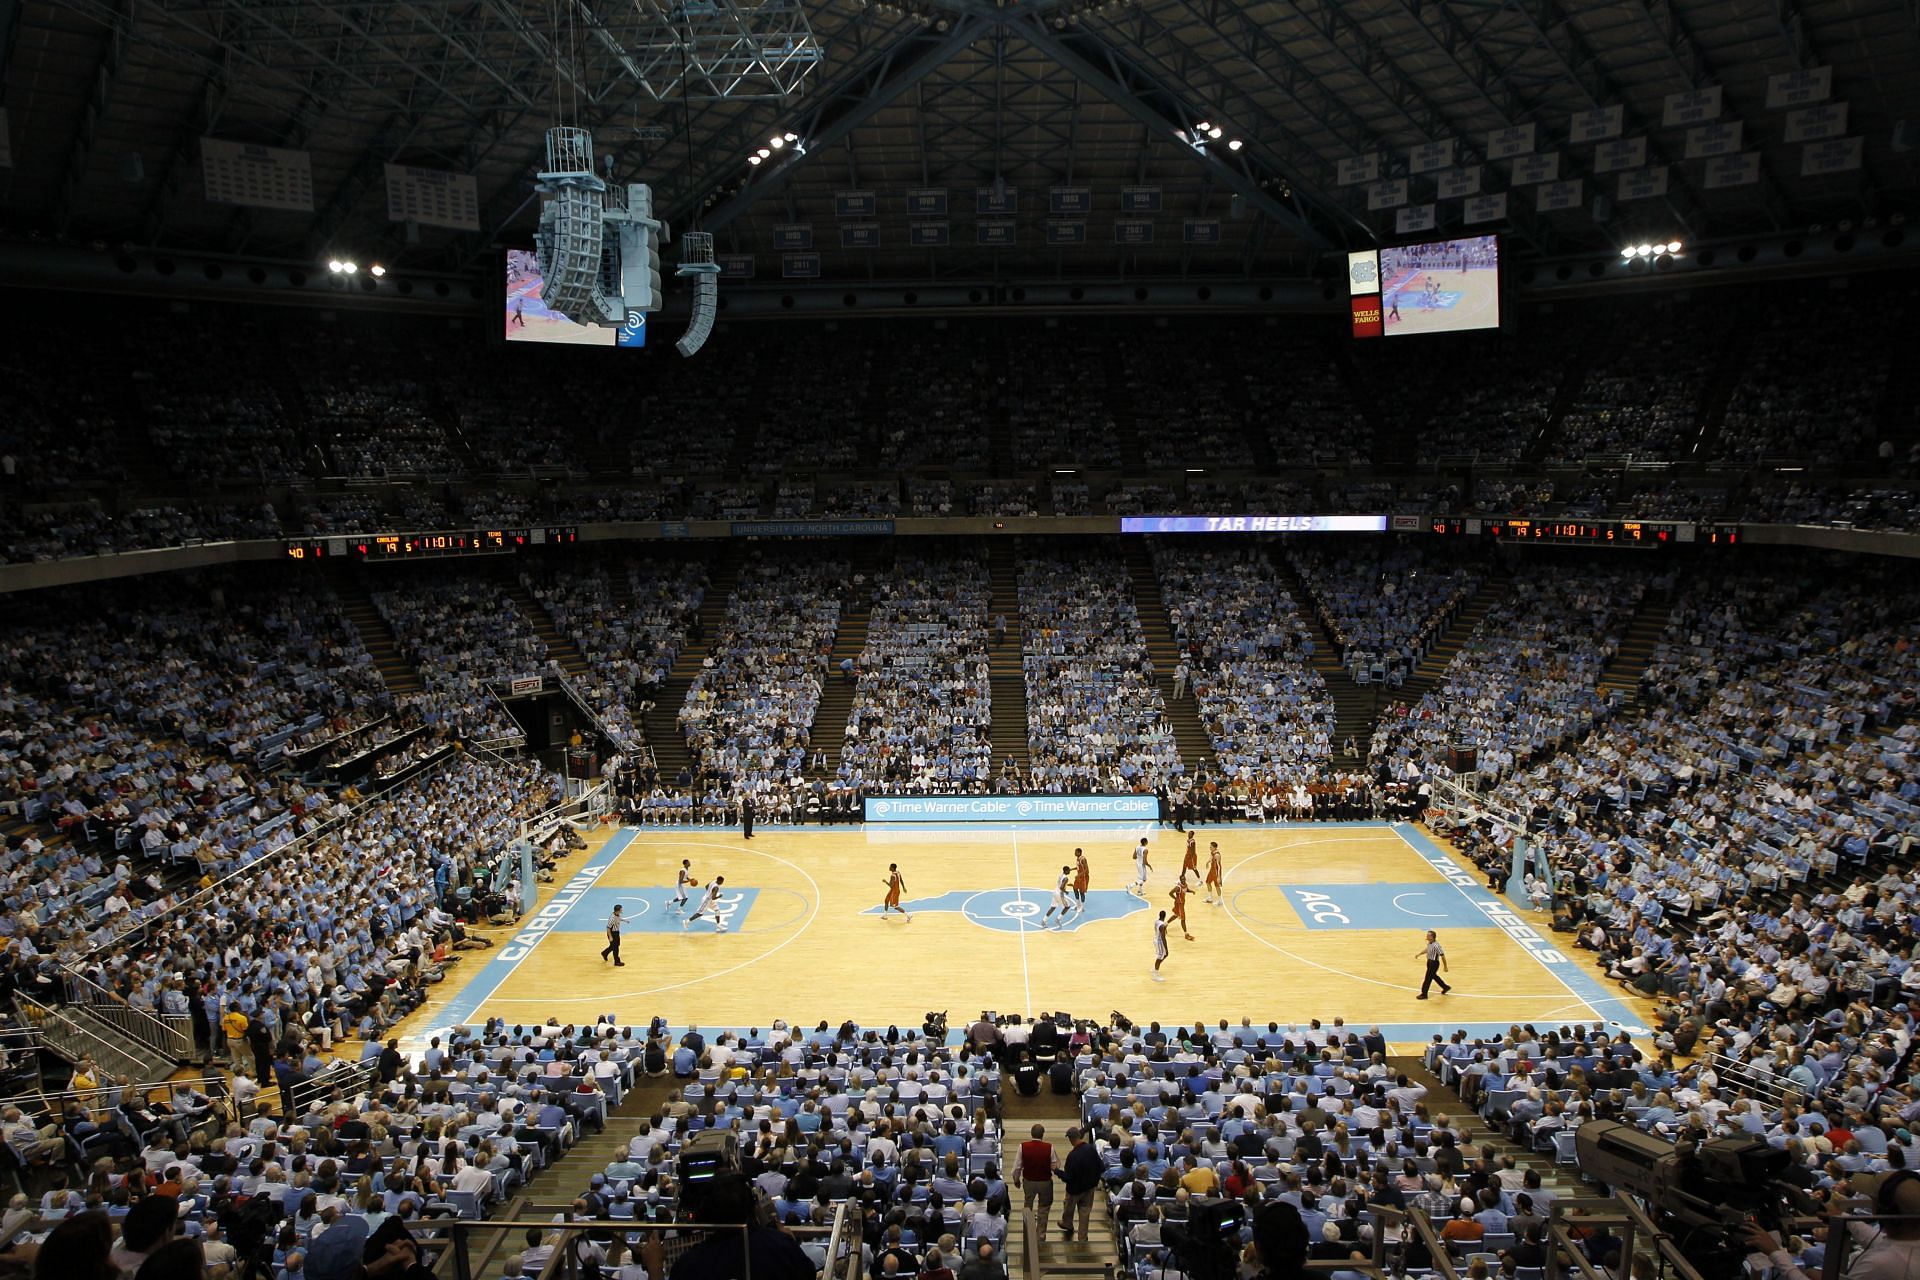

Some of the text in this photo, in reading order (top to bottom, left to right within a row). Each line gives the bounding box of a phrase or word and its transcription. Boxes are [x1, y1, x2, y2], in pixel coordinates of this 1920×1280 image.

[1355, 316, 1379, 324] FARGO
[737, 523, 888, 534] UNIVERSITY OF NORTH CAROLINA
[1207, 517, 1245, 531] TAR
[1252, 517, 1313, 531] HEELS
[1434, 525, 1445, 533] 40
[1517, 527, 1526, 536] 19
[1555, 525, 1584, 536] 11:01
[1633, 530, 1640, 540] 9
[425, 536, 452, 548] 11:01
[496, 537, 502, 546] 9
[1659, 532, 1667, 541] 4
[289, 548, 304, 558] 40
[386, 543, 397, 553] 19
[514, 679, 540, 690] ESPN
[891, 801, 1008, 812] Time Warner Cable
[1034, 800, 1150, 812] Time Warner Cable
[1296, 890, 1350, 924] ACC
[1431, 856, 1568, 964] TAR HEELS
[497, 865, 607, 961] CAROLINA
